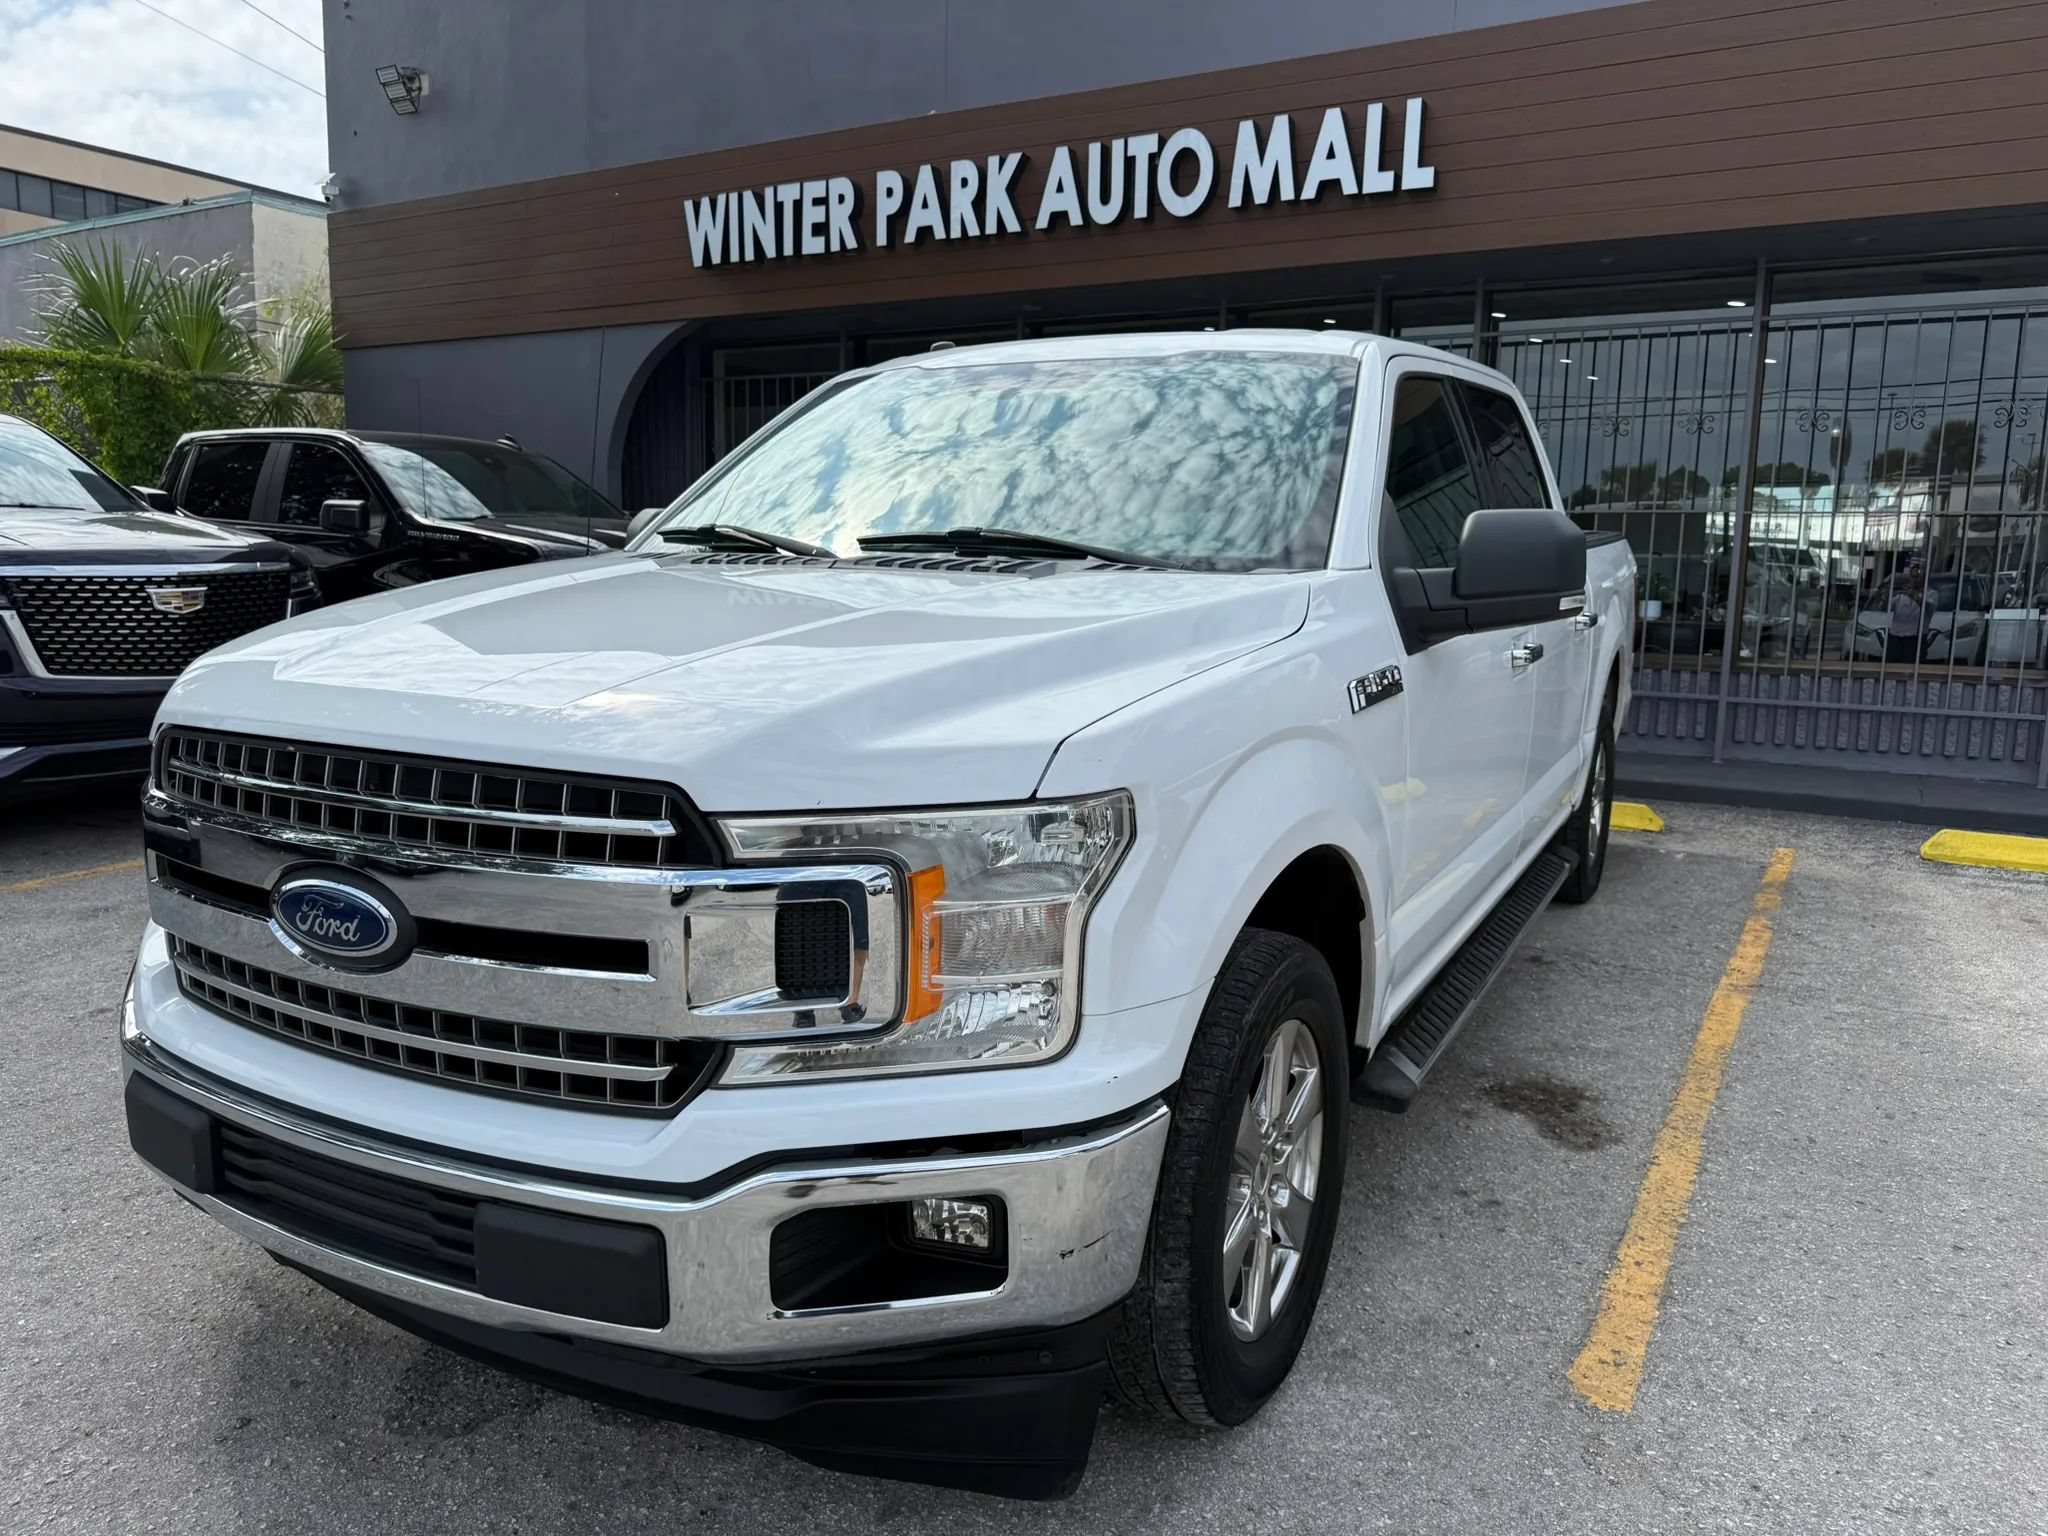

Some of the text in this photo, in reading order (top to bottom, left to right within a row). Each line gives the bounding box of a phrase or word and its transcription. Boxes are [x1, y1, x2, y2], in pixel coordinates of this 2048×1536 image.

[683, 97, 1436, 268] WINTER PARK AUTO MALL
[295, 894, 361, 942] Ford
